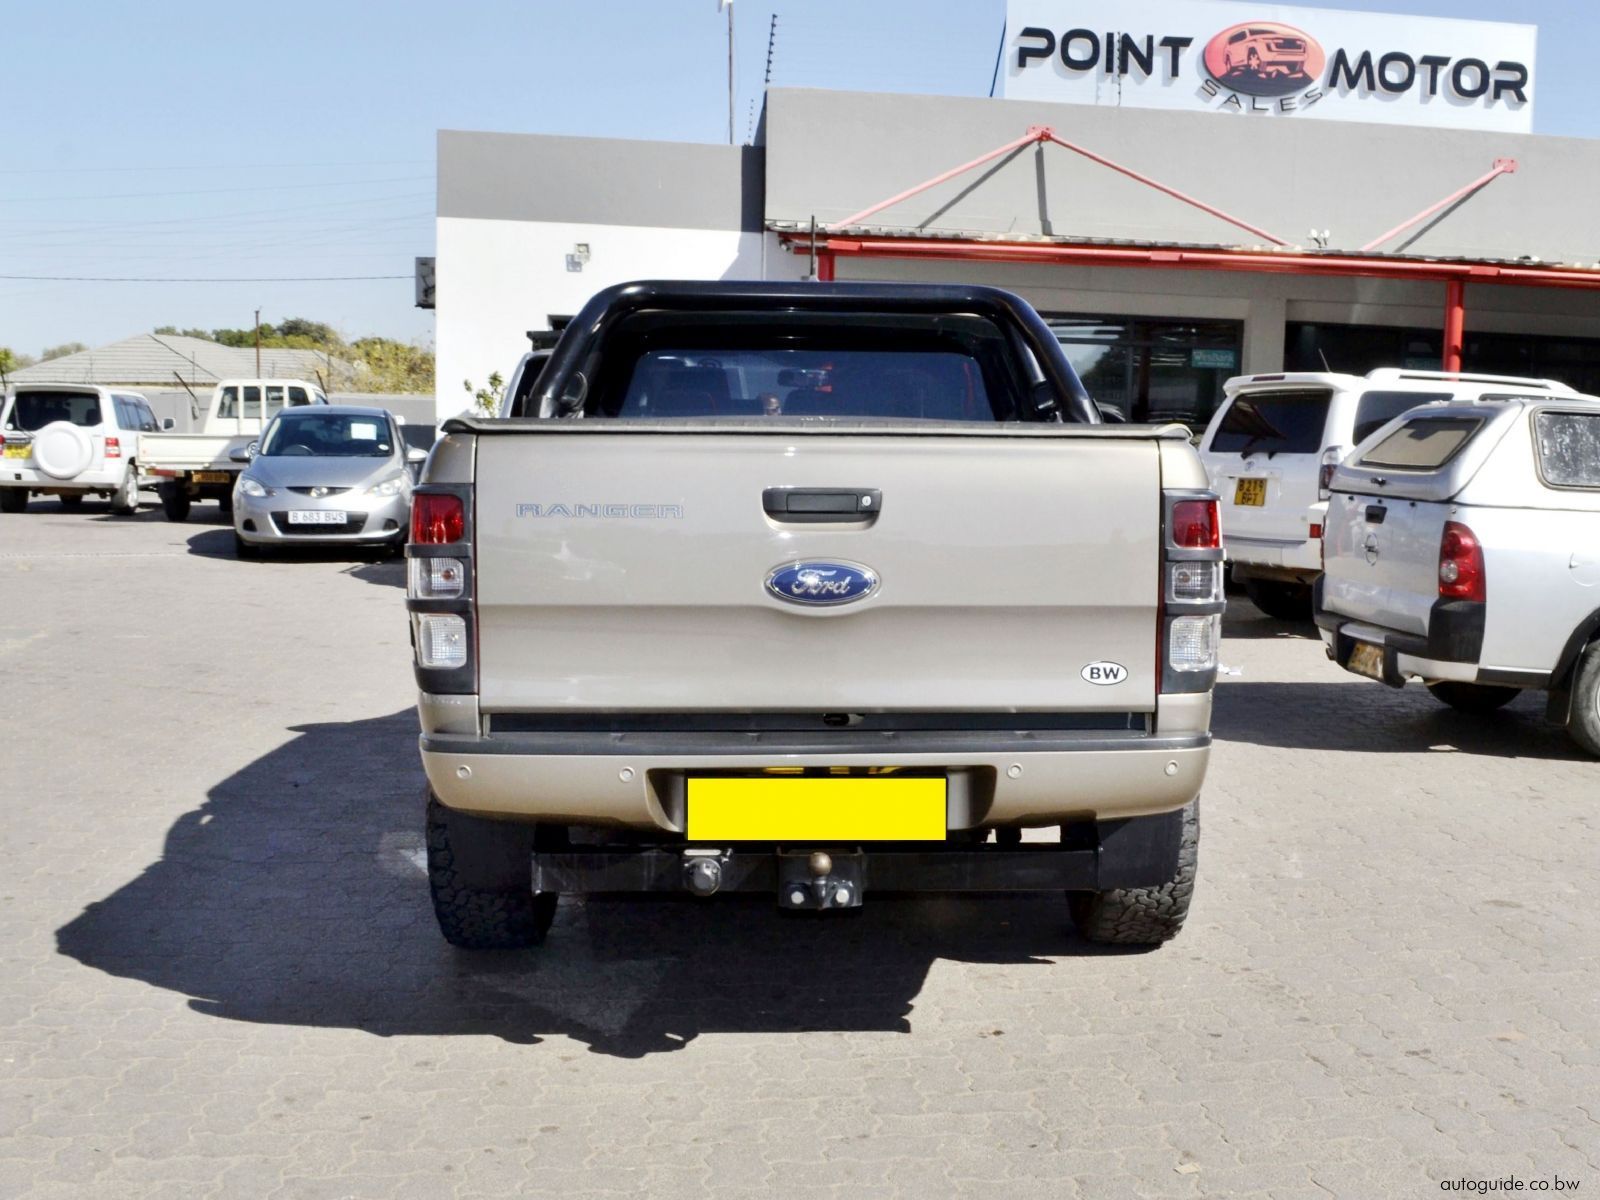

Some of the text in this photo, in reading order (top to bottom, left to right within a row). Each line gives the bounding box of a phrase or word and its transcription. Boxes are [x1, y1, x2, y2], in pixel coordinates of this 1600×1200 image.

[1018, 27, 1528, 103] POINT MOTOR
[1200, 78, 1323, 112] SALES
[516, 503, 684, 518] RANGER
[791, 569, 852, 595] Ford
[1090, 666, 1120, 680] BW
